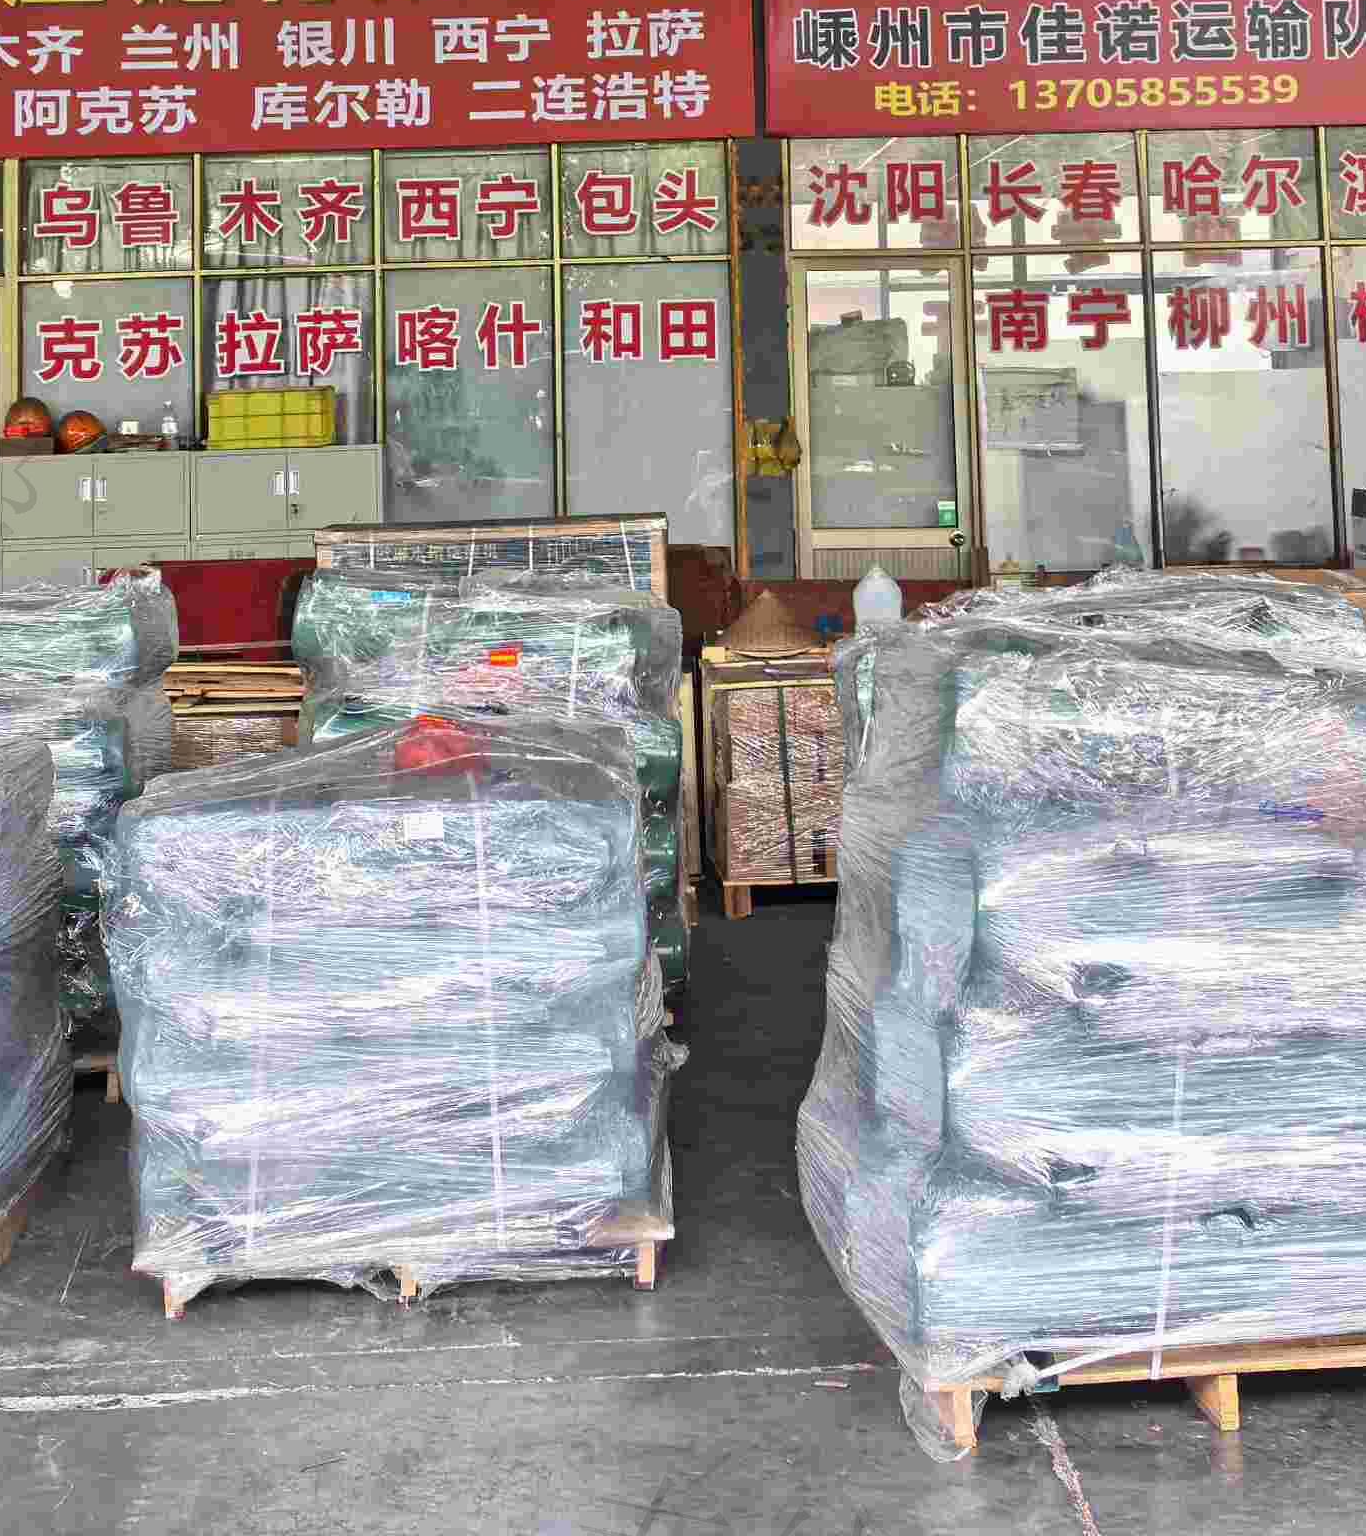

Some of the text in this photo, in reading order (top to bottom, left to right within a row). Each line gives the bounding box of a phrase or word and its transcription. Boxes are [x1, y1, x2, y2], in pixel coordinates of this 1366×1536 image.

[121, 22, 240, 71] 兰州
[276, 17, 395, 68] 银川
[432, 13, 551, 64] 西宁
[587, 8, 705, 59] 拉萨
[13, 85, 198, 137] 阿克苏
[251, 78, 432, 131] 库尔勒
[469, 70, 711, 122] 二连浩特
[395, 174, 541, 242] 西宁
[575, 166, 719, 237] 包头
[806, 158, 947, 228] 沈阳
[984, 158, 1124, 227] 长春
[215, 305, 363, 377] 拉萨
[395, 301, 542, 370] 喀什
[579, 298, 718, 363] 和田
[984, 287, 1133, 354] 南宁
[1166, 283, 1312, 352] 柳州
